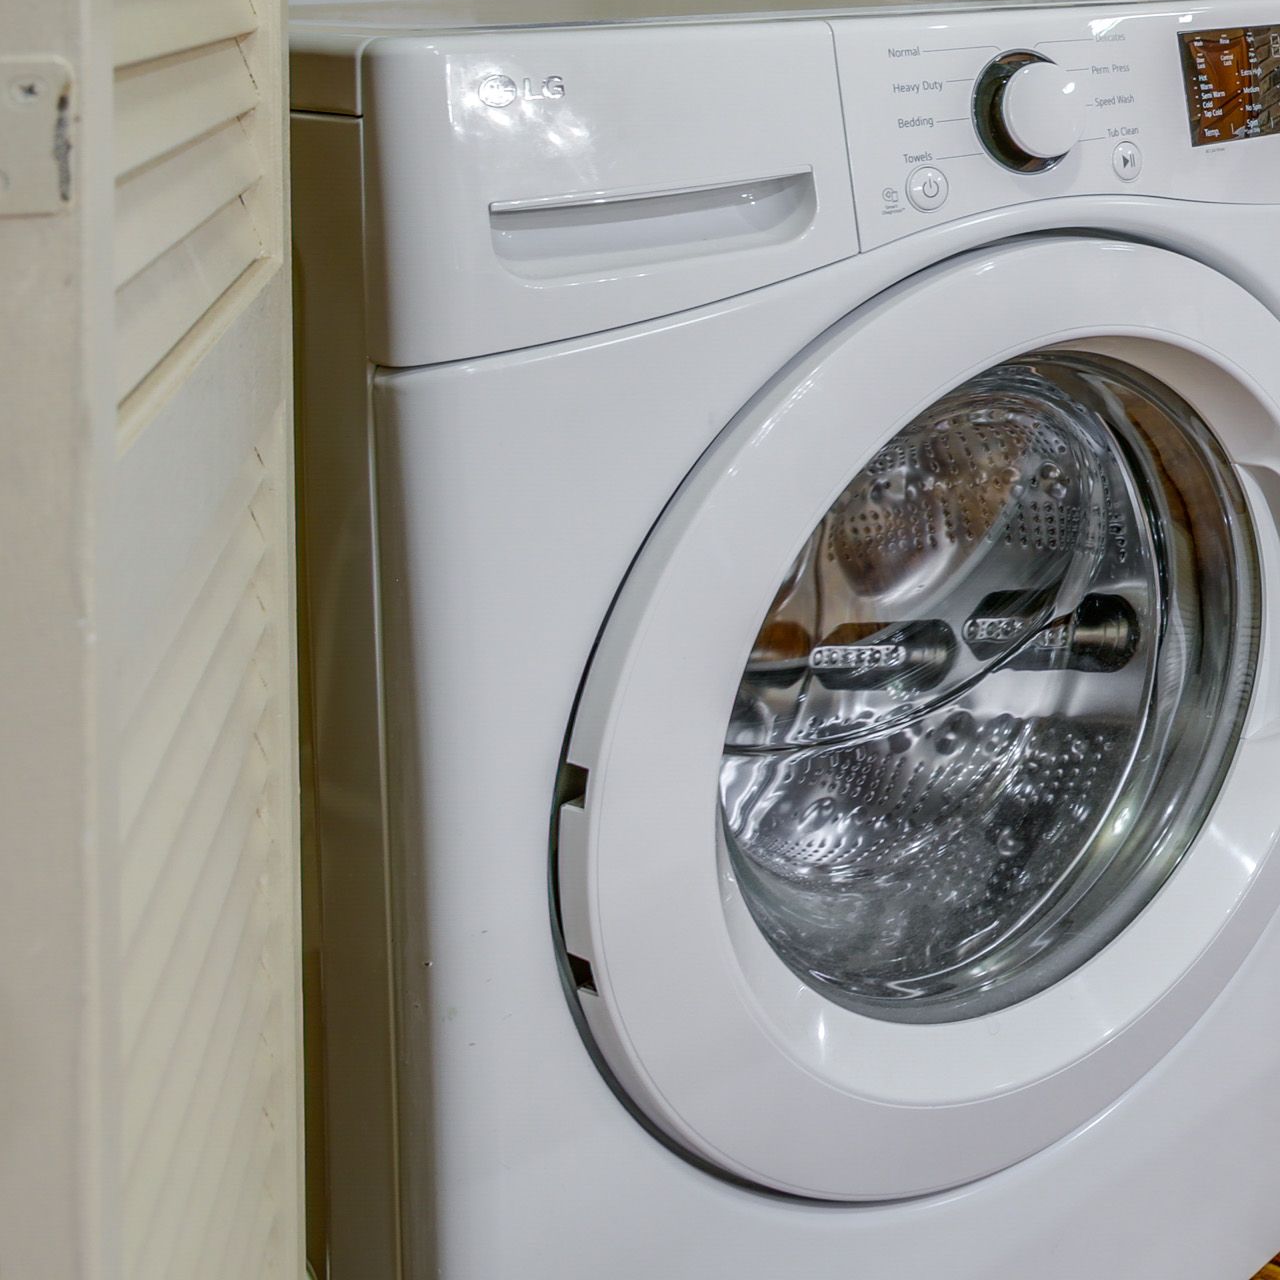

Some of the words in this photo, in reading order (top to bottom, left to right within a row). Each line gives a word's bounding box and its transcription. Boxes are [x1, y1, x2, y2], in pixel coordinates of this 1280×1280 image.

[887, 47, 920, 58] Normal
[1112, 64, 1130, 73] Press
[523, 75, 565, 101] LG
[892, 82, 920, 94] Heavy
[922, 80, 943, 92] Duty
[1094, 95, 1116, 109] Speed
[1116, 93, 1135, 104] Wash
[897, 117, 934, 128] Bedding
[1107, 128, 1119, 138] Tub
[1120, 126, 1139, 136] Clean
[903, 151, 934, 163] Towels
